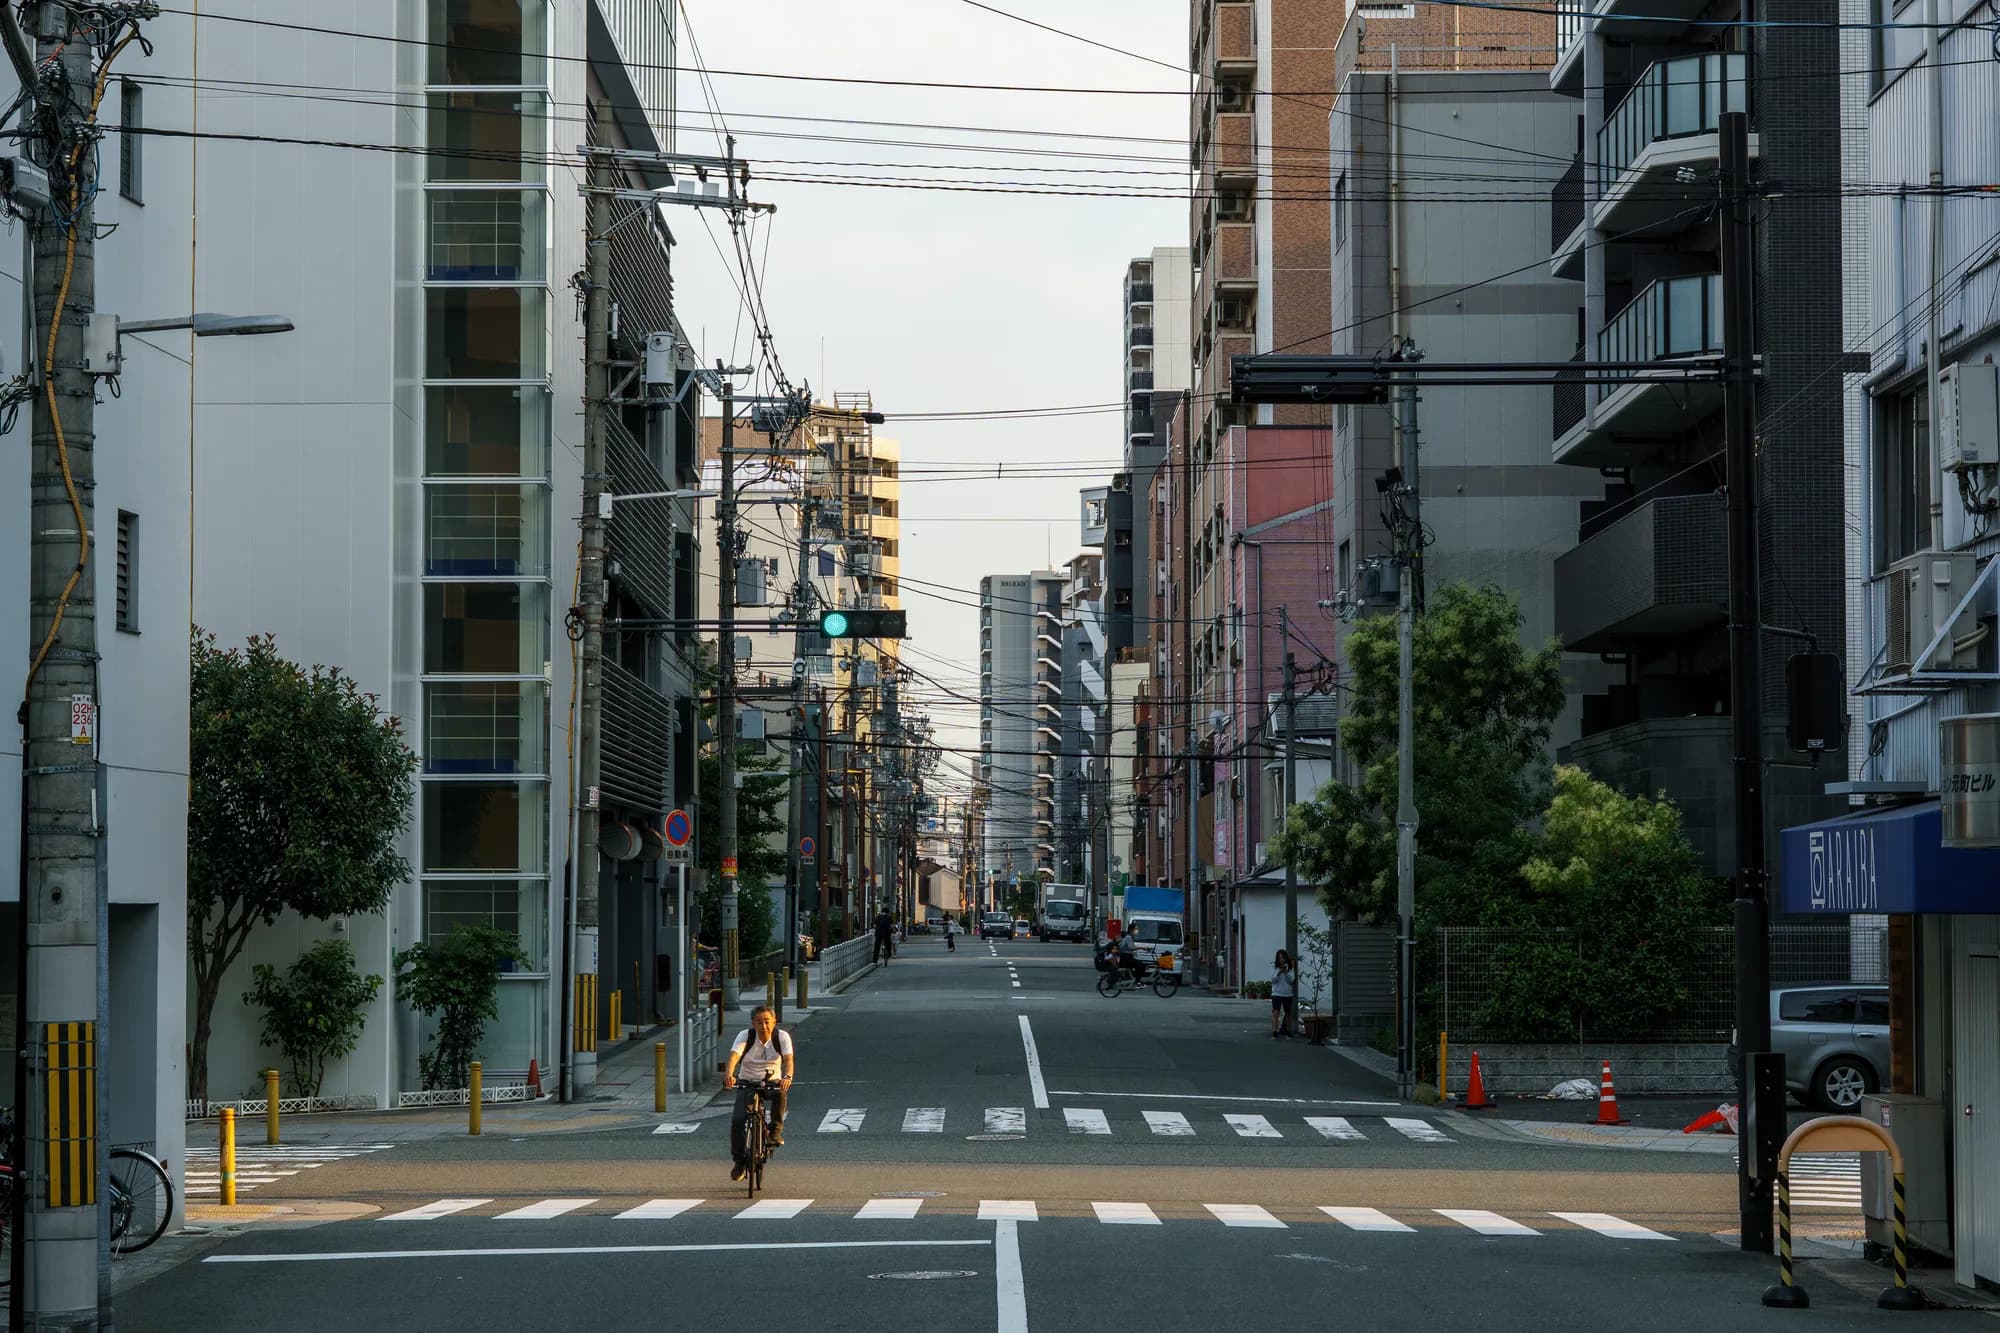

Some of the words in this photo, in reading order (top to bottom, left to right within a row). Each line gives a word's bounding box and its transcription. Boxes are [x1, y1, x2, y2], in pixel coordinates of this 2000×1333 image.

[73, 703, 92, 713] 02H
[73, 714, 92, 725] 236
[1828, 828, 1878, 910] ARAIBA
